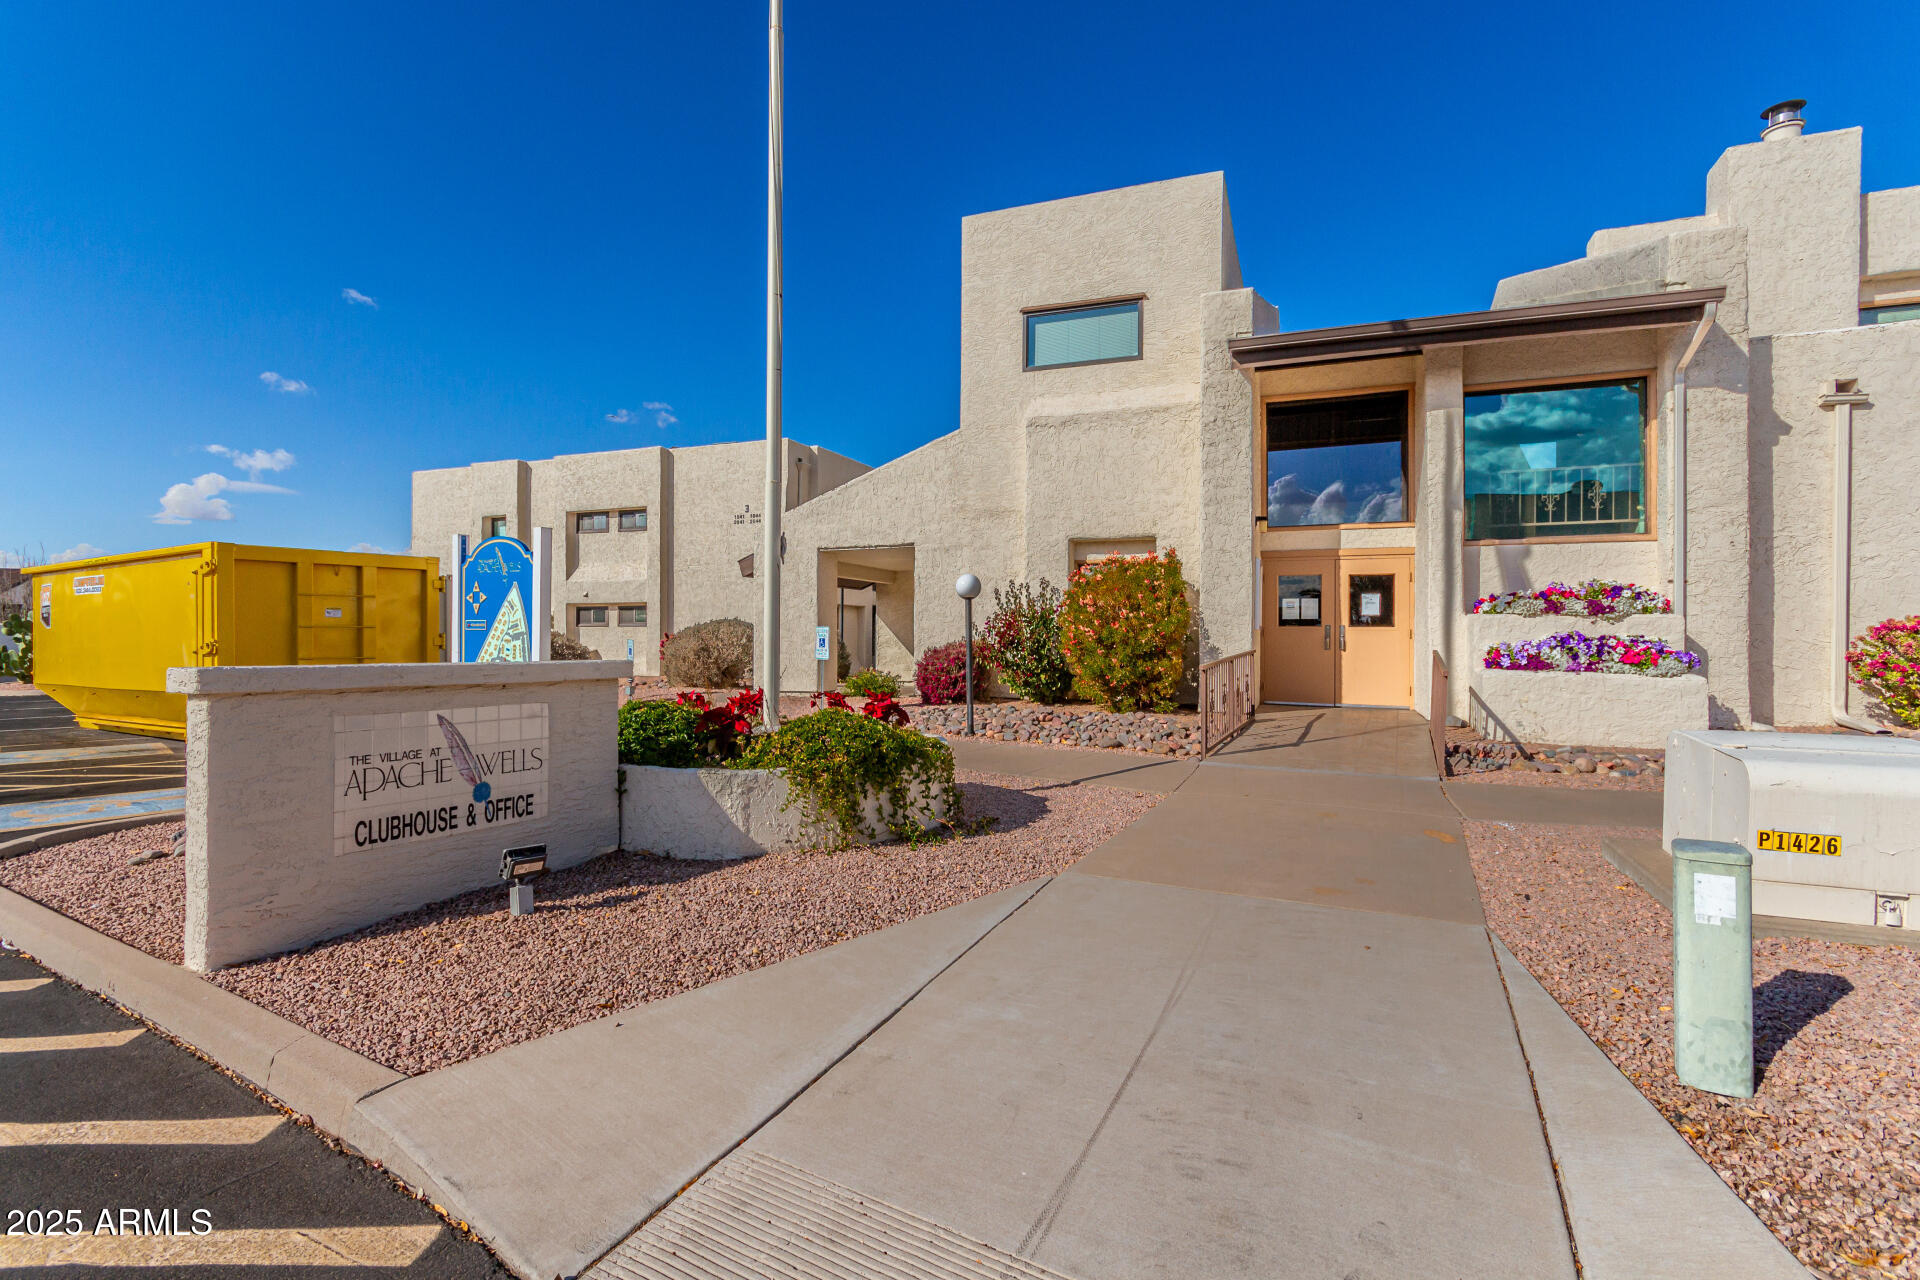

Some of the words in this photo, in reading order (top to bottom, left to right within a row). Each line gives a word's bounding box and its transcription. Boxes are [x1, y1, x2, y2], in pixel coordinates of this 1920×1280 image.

[744, 504, 750, 513] 3
[350, 755, 372, 766] THE
[379, 749, 423, 763] VILLAGE
[429, 747, 442, 758] AT
[343, 758, 453, 801] APACHE
[476, 747, 543, 777] WELLS
[354, 805, 459, 847] CLUBHOUSE
[466, 803, 477, 827] &
[484, 793, 535, 823] OFFICE
[1758, 832, 1839, 855] P1426
